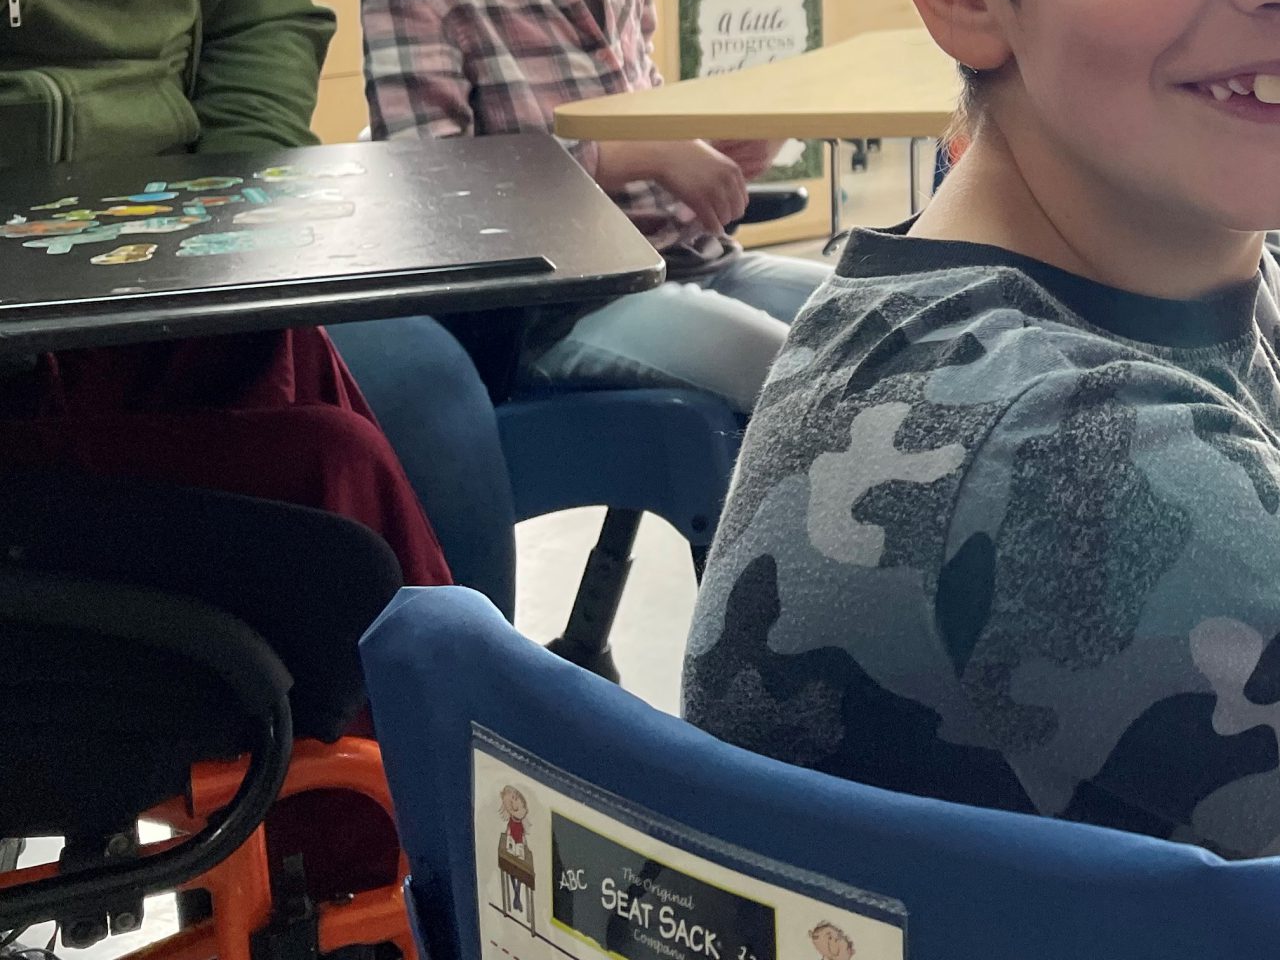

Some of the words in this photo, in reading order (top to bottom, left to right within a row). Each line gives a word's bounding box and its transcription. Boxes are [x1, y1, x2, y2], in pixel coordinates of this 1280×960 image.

[739, 7, 786, 32] little
[711, 35, 795, 58] progress
[559, 868, 587, 890] ABC
[622, 867, 642, 886] The
[643, 878, 695, 910] Original
[601, 877, 654, 929] SEAT
[659, 905, 720, 960] SACK
